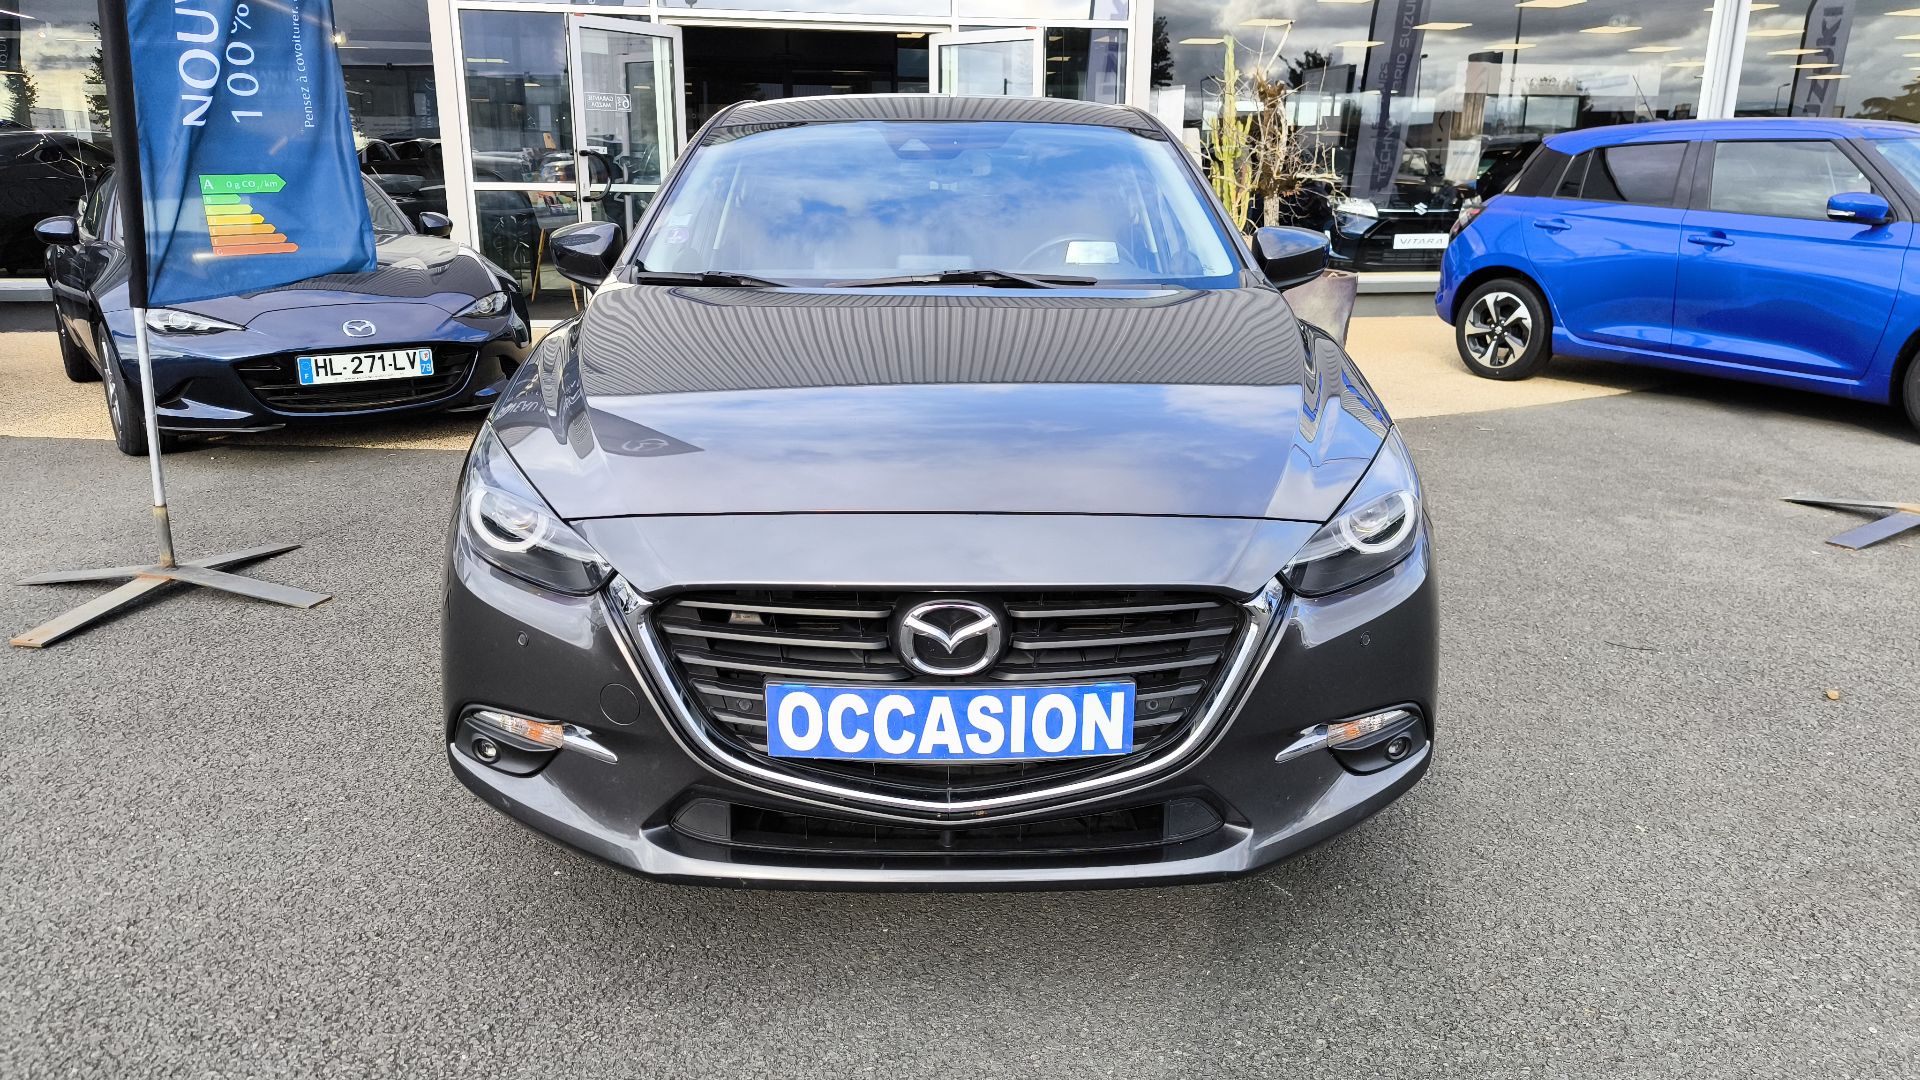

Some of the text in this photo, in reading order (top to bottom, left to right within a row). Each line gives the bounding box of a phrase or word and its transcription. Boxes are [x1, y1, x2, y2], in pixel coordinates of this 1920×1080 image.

[296, 75, 308, 83] à
[300, 86, 315, 128] Pensez
[203, 179, 214, 190] A
[1399, 237, 1444, 245] VITARA
[314, 351, 417, 377] HL-271-LV
[421, 363, 432, 374] 79
[778, 691, 1125, 754] OCCASION
